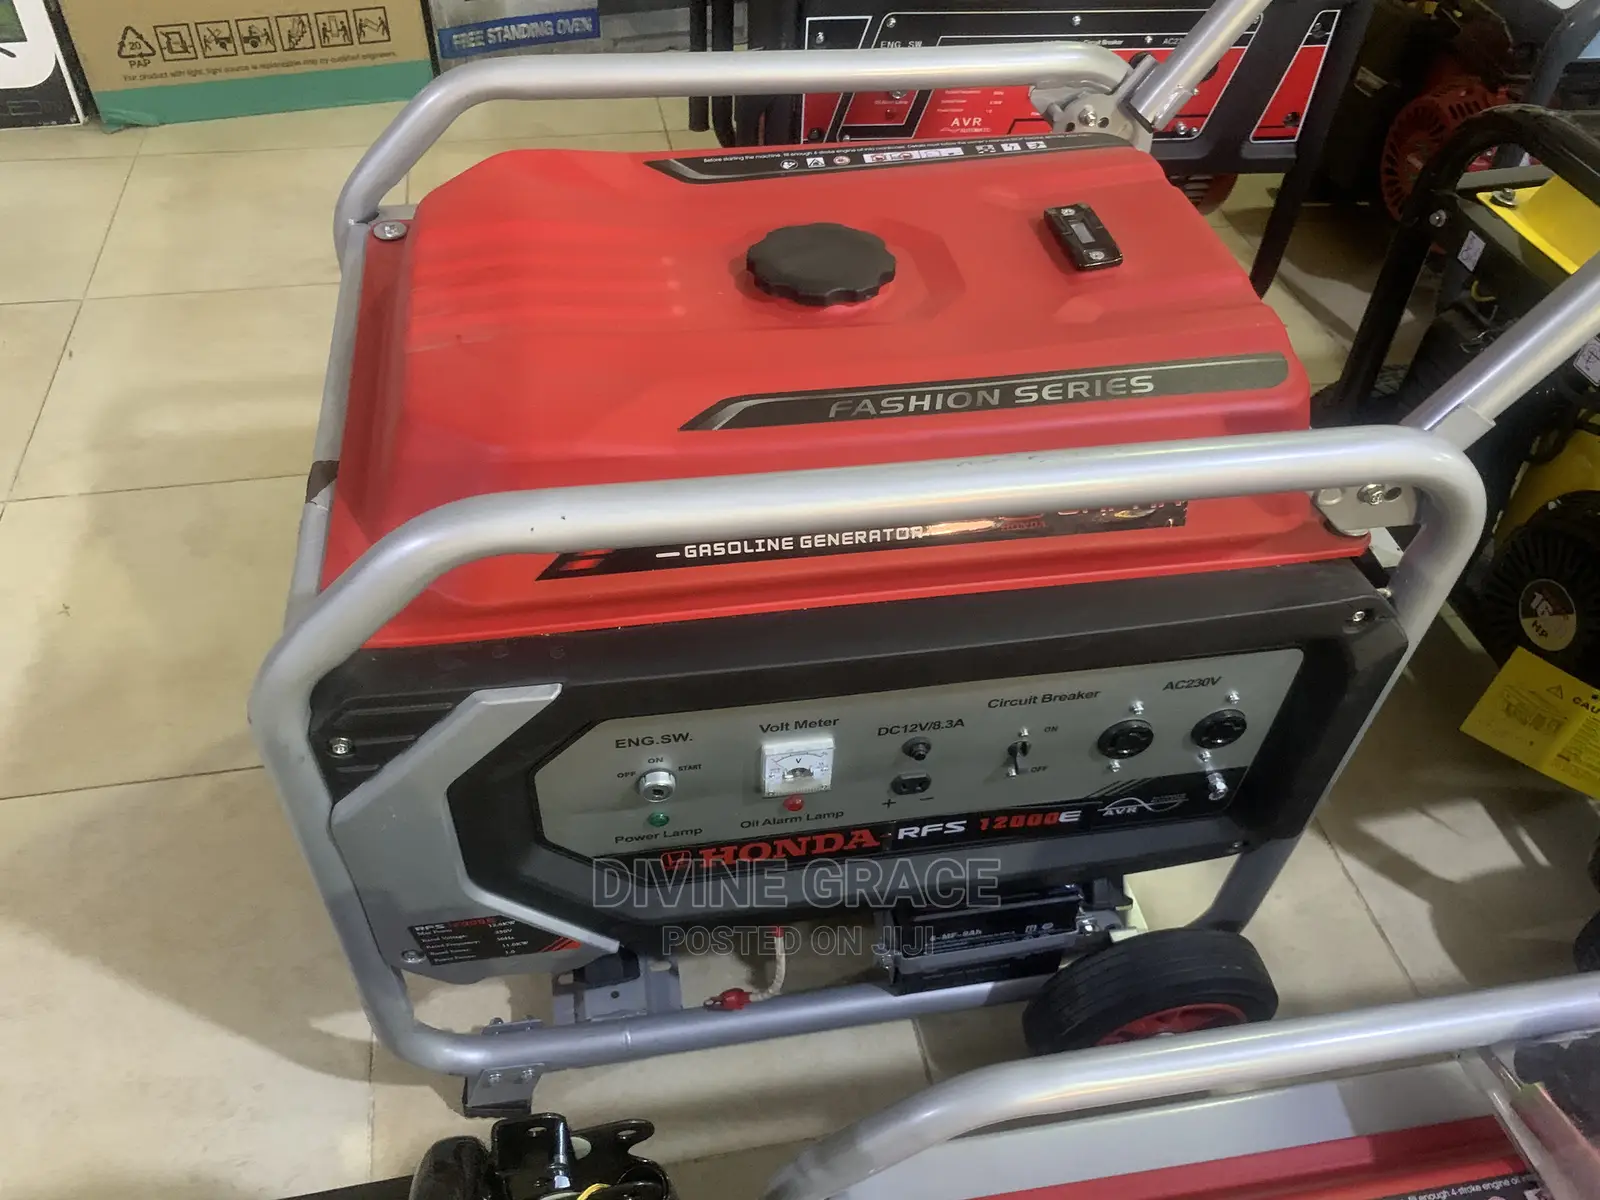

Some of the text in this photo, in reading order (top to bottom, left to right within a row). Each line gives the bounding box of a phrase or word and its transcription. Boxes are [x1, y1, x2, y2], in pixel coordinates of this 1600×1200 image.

[452, 16, 592, 49] FREE STANDING OVEN
[128, 59, 152, 69] PAP
[950, 116, 983, 127] AVR
[829, 375, 1155, 418] FASHION SERIES
[684, 525, 923, 558] GASOLINE GENERATOR
[1531, 620, 1549, 638] HP
[1162, 676, 1222, 691] AC230V
[988, 690, 1101, 709] Circuit Breaker
[759, 718, 840, 733] Volt Meter
[877, 718, 965, 737] DC12V/8.3A
[615, 732, 693, 749] ENG.SW.
[678, 764, 702, 772] START
[1030, 765, 1048, 773] OFF
[740, 809, 844, 829] Oil Alarm Lamp
[1102, 805, 1138, 817] AVR
[896, 810, 1084, 840] RFS 12000E
[614, 827, 703, 844] Power Lamp
[701, 830, 882, 868] HONDA
[1450, 1184, 1481, 1196] 4-stroke
[1482, 1180, 1509, 1190] engine
